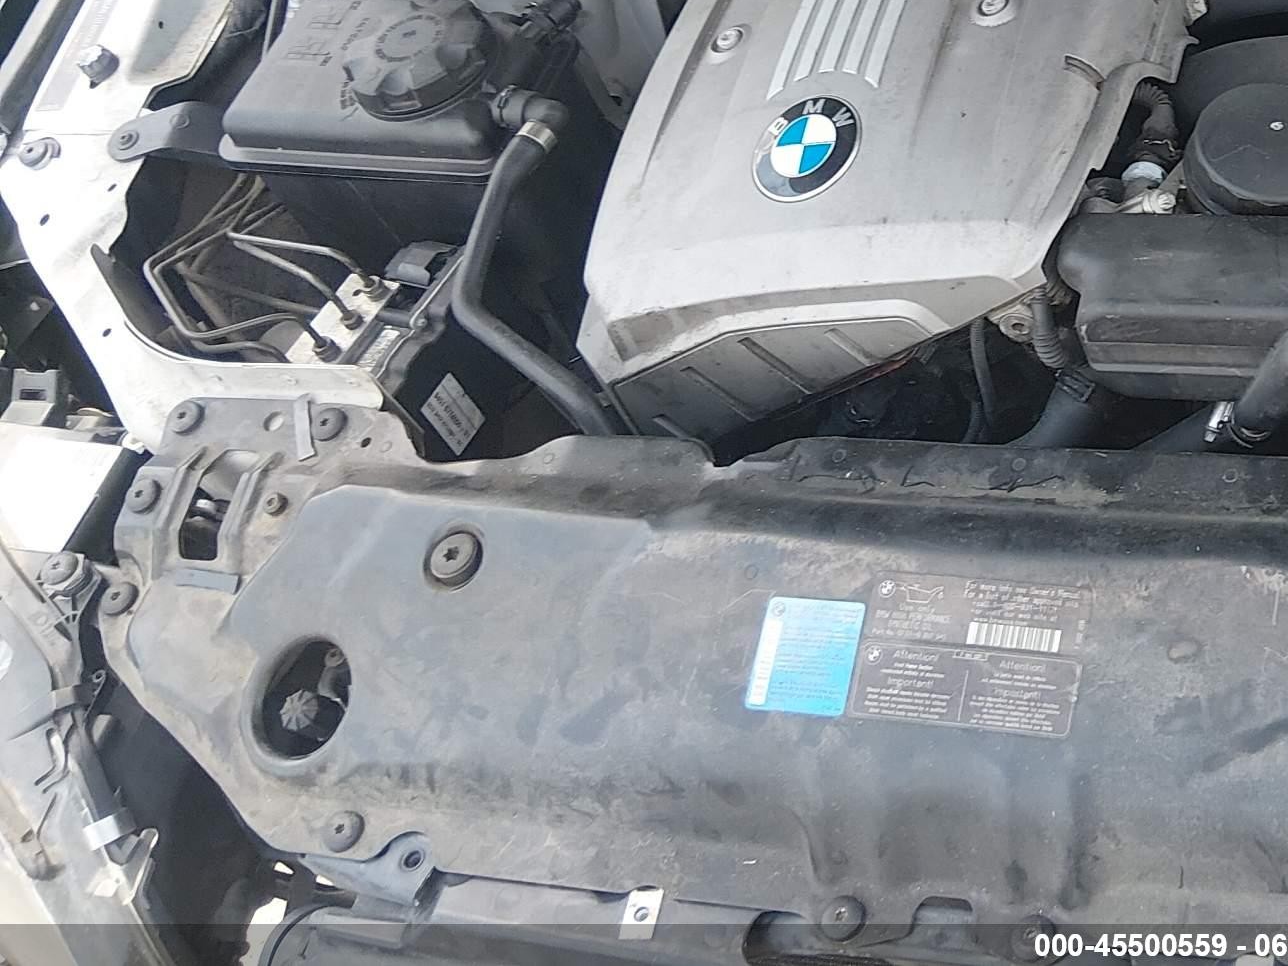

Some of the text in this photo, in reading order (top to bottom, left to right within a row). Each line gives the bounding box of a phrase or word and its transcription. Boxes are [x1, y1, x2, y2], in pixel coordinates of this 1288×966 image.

[768, 99, 855, 136] BMW
[892, 649, 940, 662] Attention!
[999, 659, 1047, 672] Attention!
[887, 676, 935, 689] Important!
